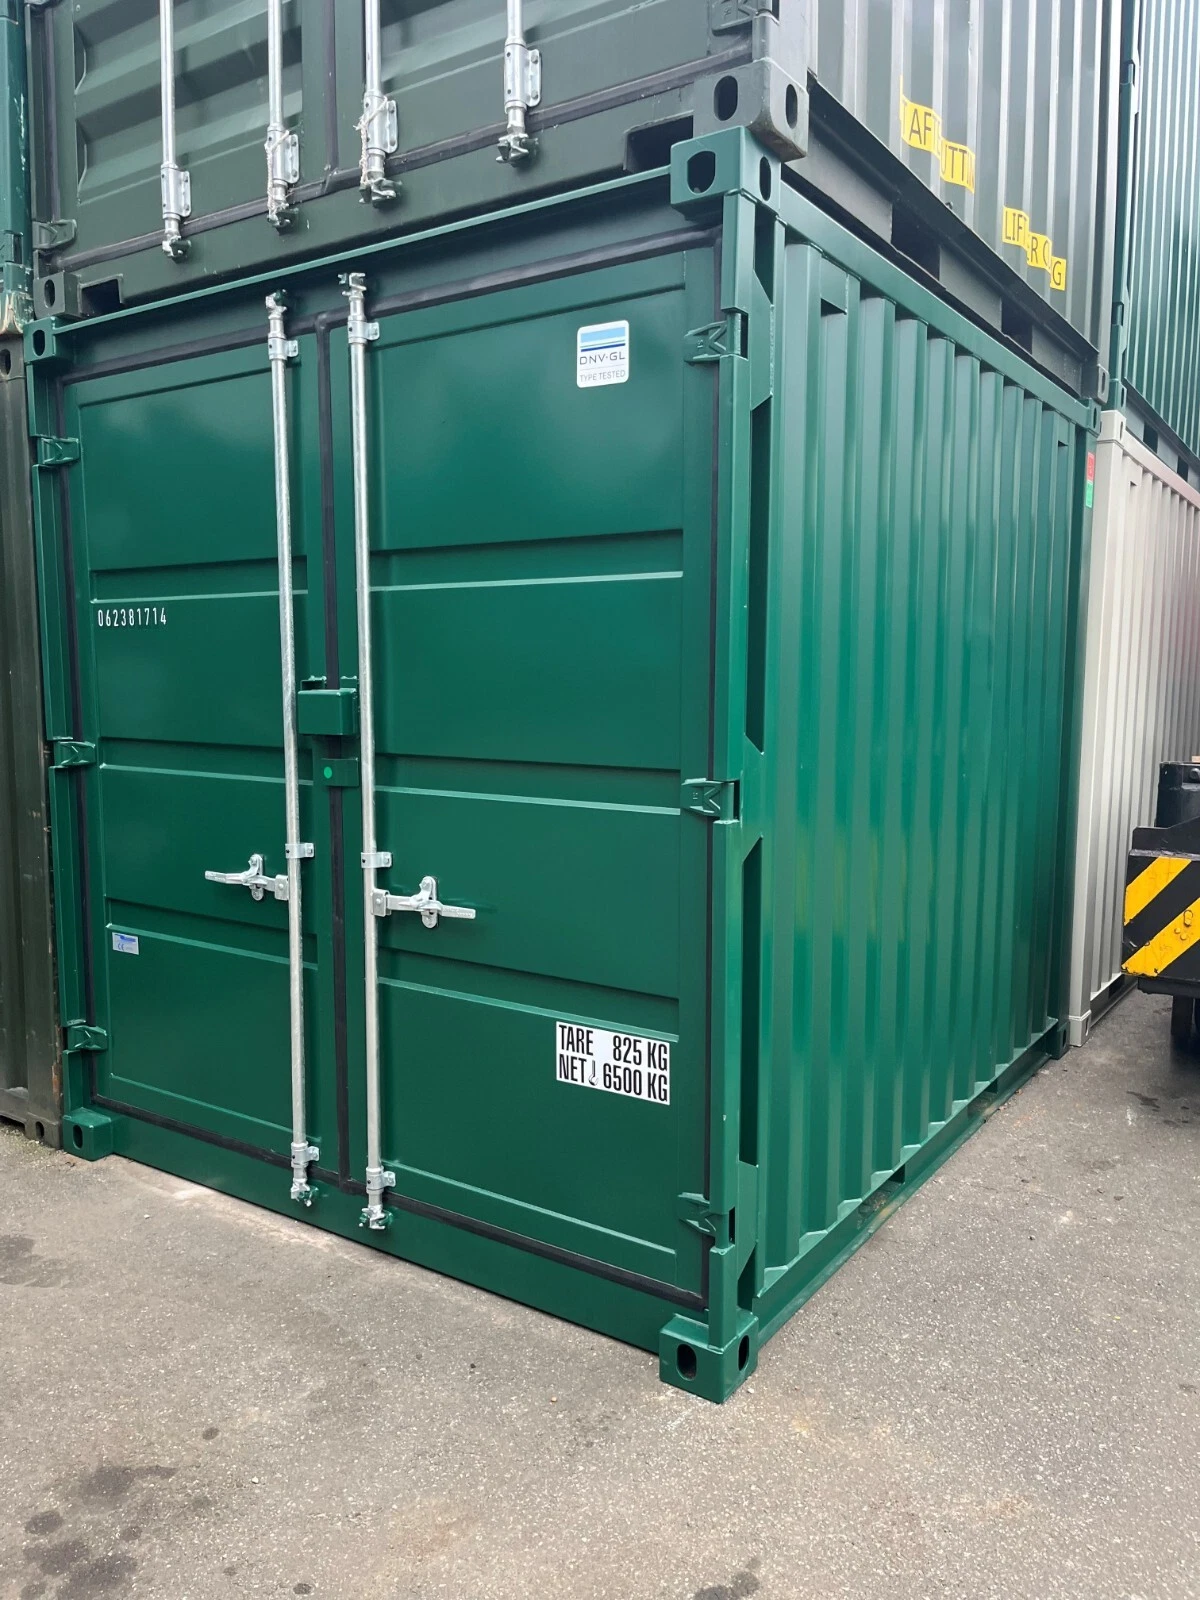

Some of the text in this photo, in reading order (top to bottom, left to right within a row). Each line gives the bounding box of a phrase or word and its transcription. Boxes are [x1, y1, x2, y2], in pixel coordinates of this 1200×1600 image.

[579, 369, 627, 383] TYPE TESTED
[97, 607, 167, 627] 062381714
[559, 1024, 668, 1072] TARE 825 KG
[559, 1053, 668, 1102] NET 6500 KG
